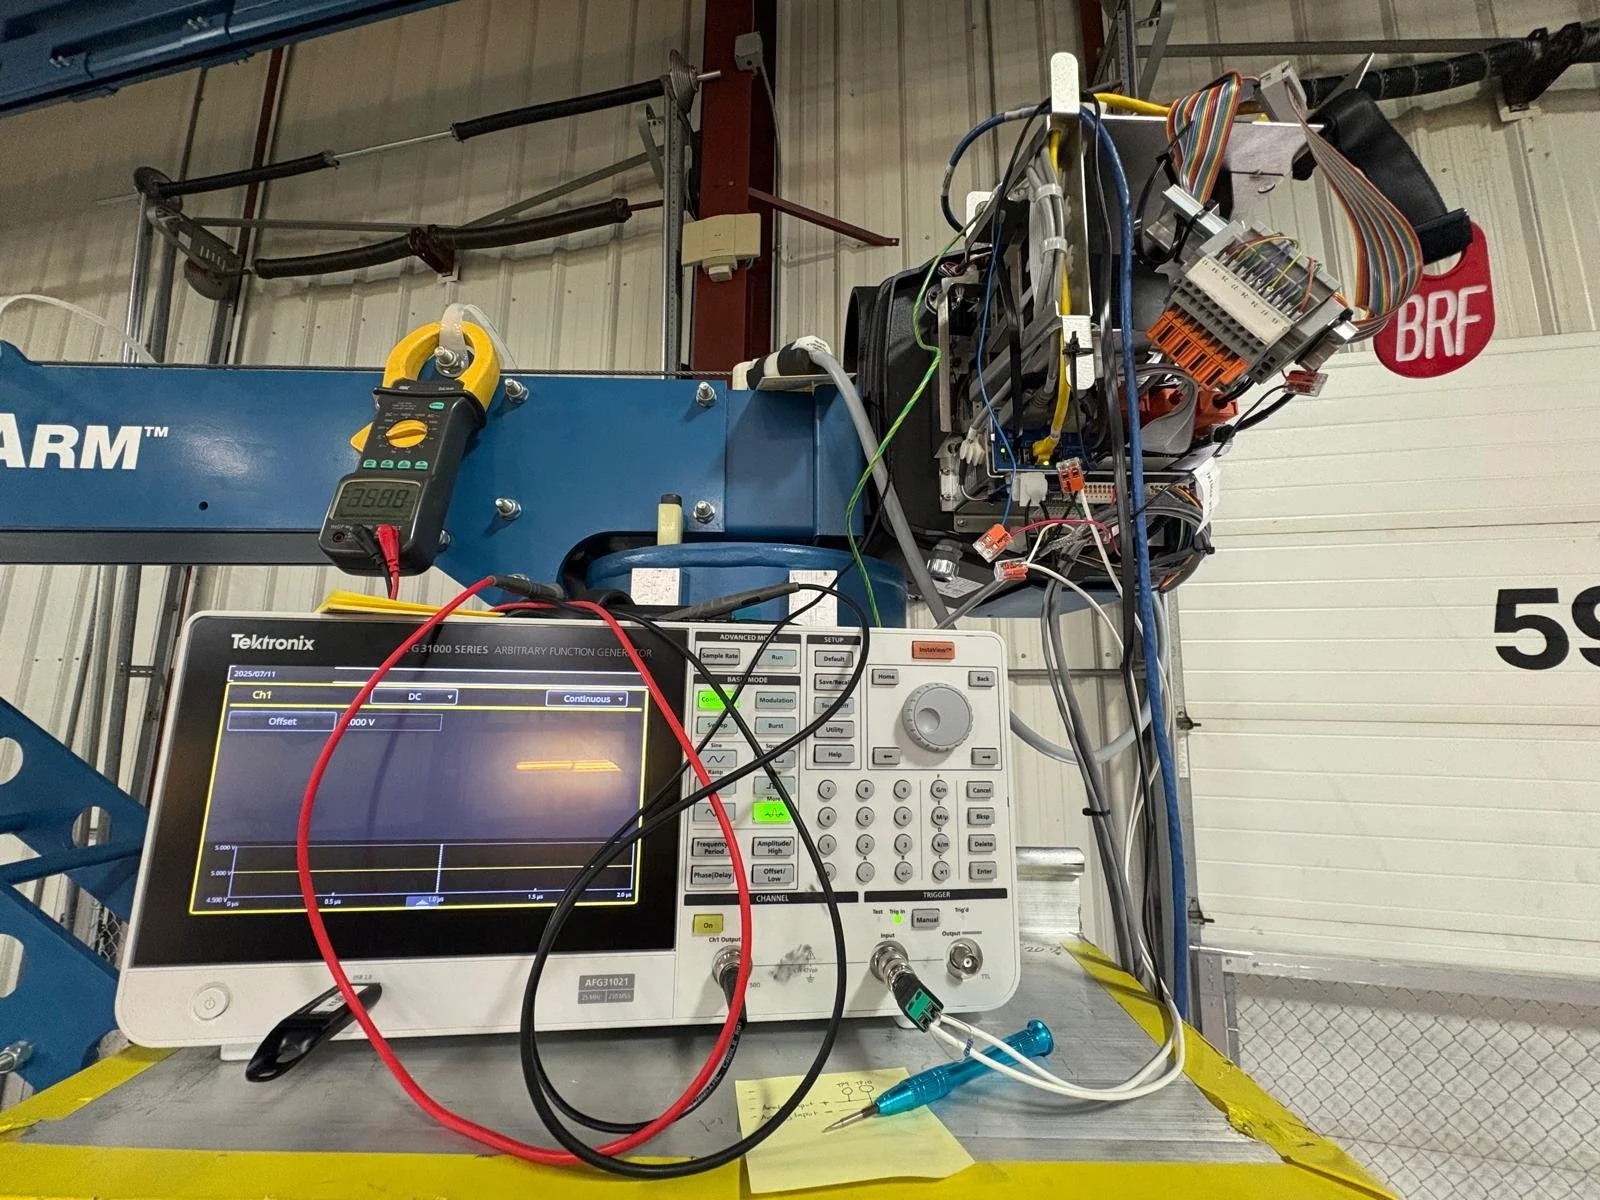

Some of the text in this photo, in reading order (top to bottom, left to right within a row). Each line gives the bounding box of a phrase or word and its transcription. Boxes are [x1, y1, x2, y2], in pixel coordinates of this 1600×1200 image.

[1395, 284, 1488, 362] BRF
[231, 633, 315, 651] Tektronix
[454, 645, 489, 654] SERIES
[494, 646, 548, 656] ARBITRARY
[549, 647, 595, 657] FUNCTION
[597, 647, 653, 658] GENERTOR
[233, 670, 276, 678] 2025/07/11
[252, 690, 272, 700] Ch1
[408, 693, 422, 701] DC
[563, 695, 611, 704] Continuous
[268, 717, 297, 726] Offset
[697, 841, 728, 849] Frequency
[757, 840, 791, 848] Amplitude/
[584, 977, 629, 987] AFG31021
